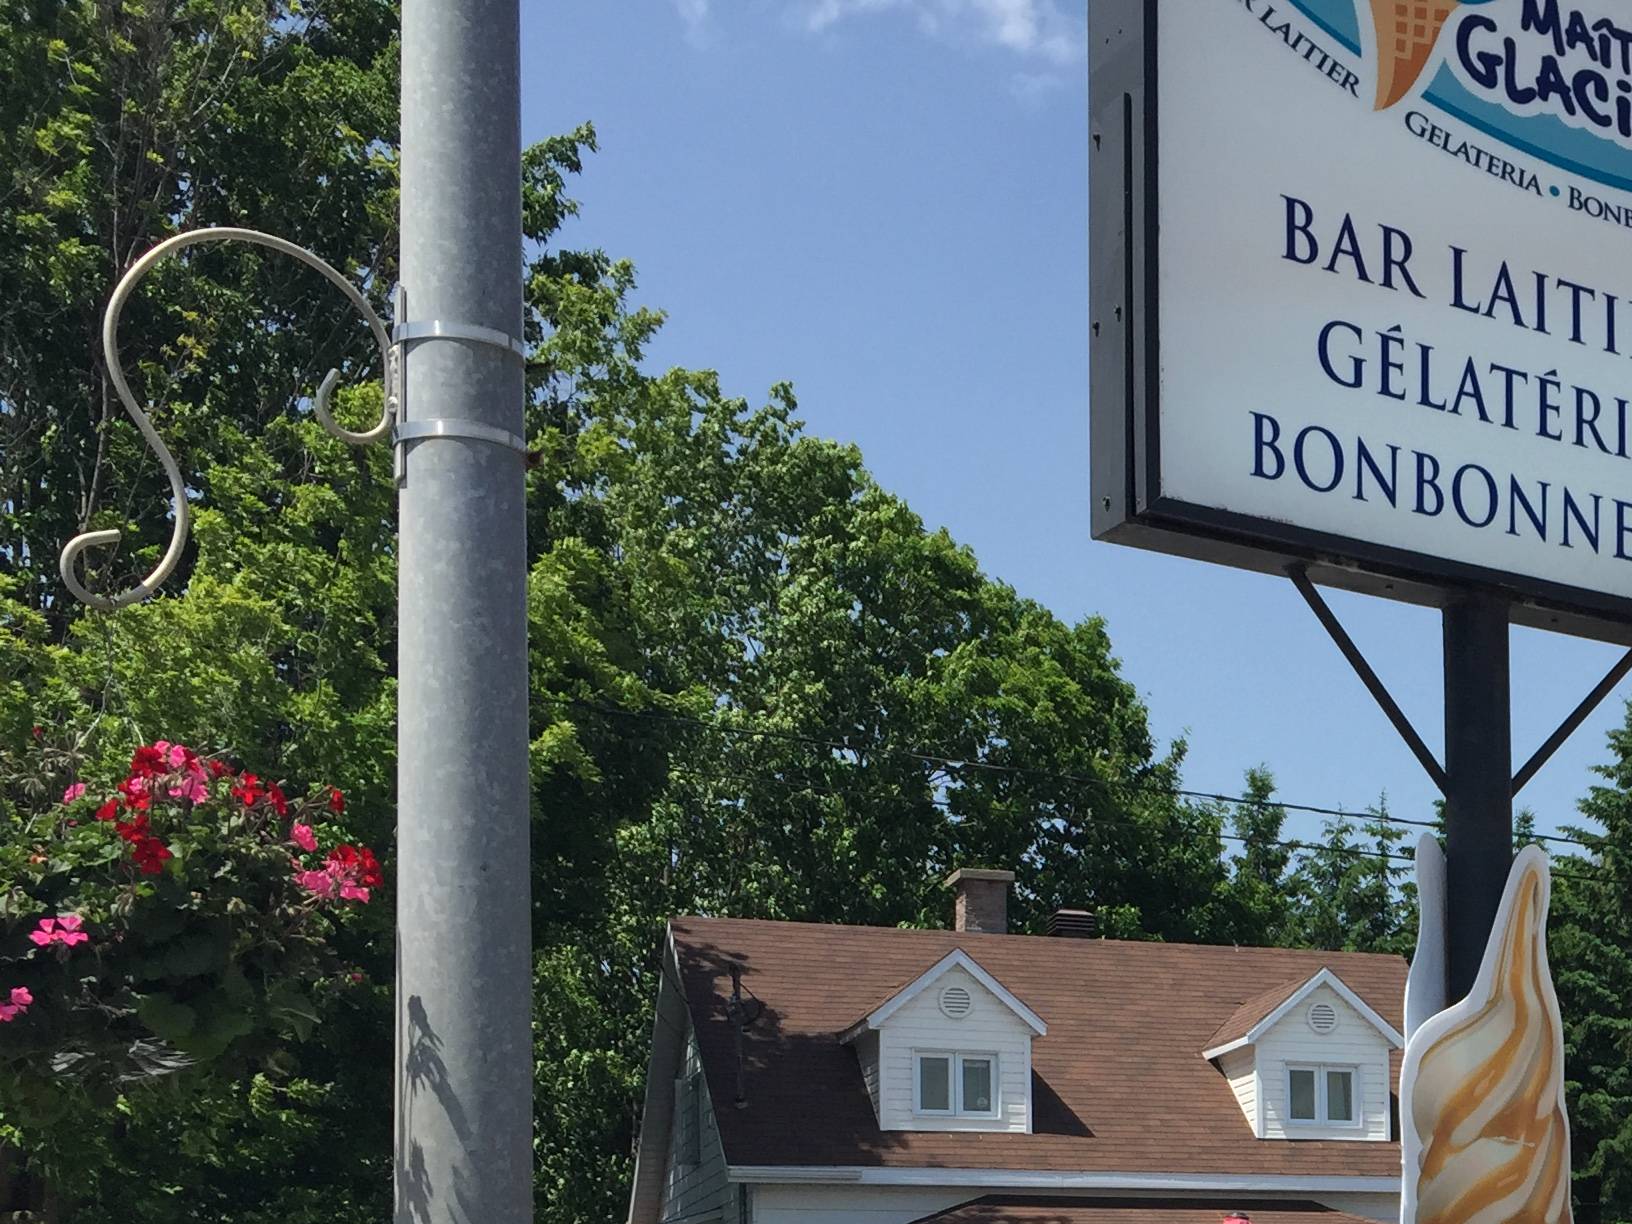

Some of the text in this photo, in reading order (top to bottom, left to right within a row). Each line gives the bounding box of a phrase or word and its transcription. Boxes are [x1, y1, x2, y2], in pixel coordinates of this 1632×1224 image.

[1258, 5, 1360, 98] LAITIER
[1404, 110, 1543, 197] GELATERIA
[1280, 194, 1427, 299] BAR
